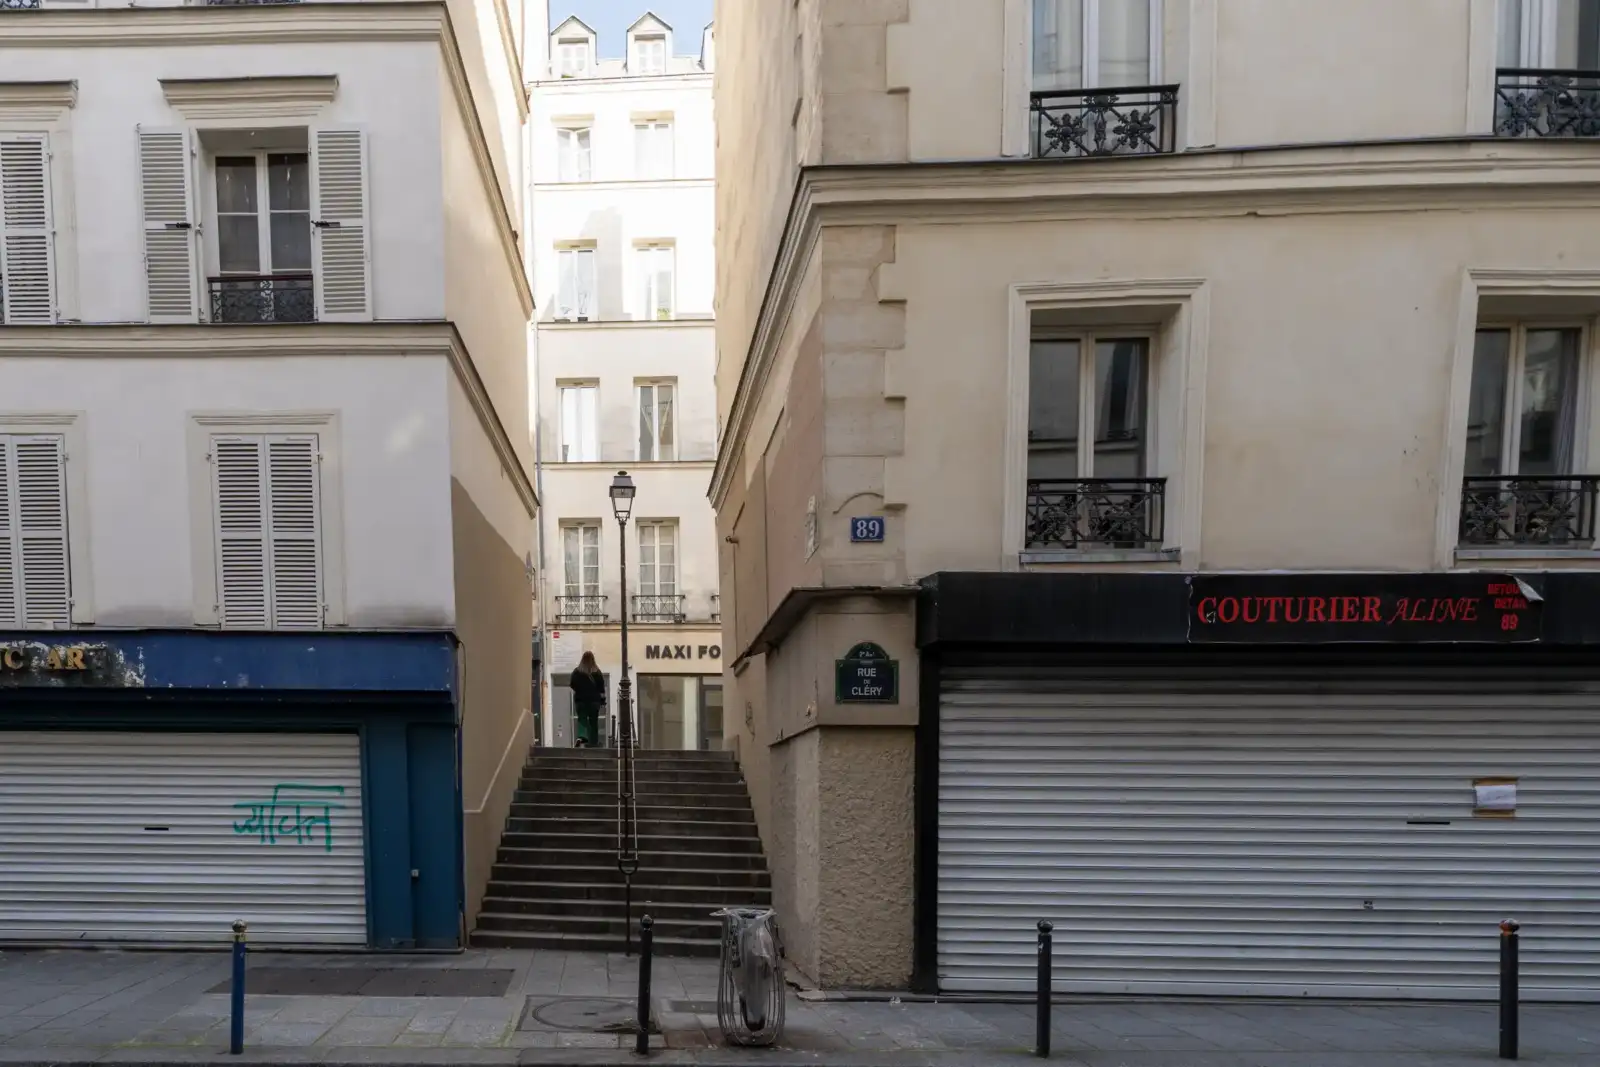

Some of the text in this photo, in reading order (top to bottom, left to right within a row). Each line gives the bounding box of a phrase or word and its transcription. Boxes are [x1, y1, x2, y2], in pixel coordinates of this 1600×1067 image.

[857, 520, 880, 538] 89
[1197, 597, 1481, 625] COUTURIER ALINE
[1501, 613, 1518, 630] 89
[0, 647, 24, 670] C
[646, 645, 721, 659] MAXI FO
[857, 668, 876, 677] RUE
[851, 685, 882, 696] CLÉRY
